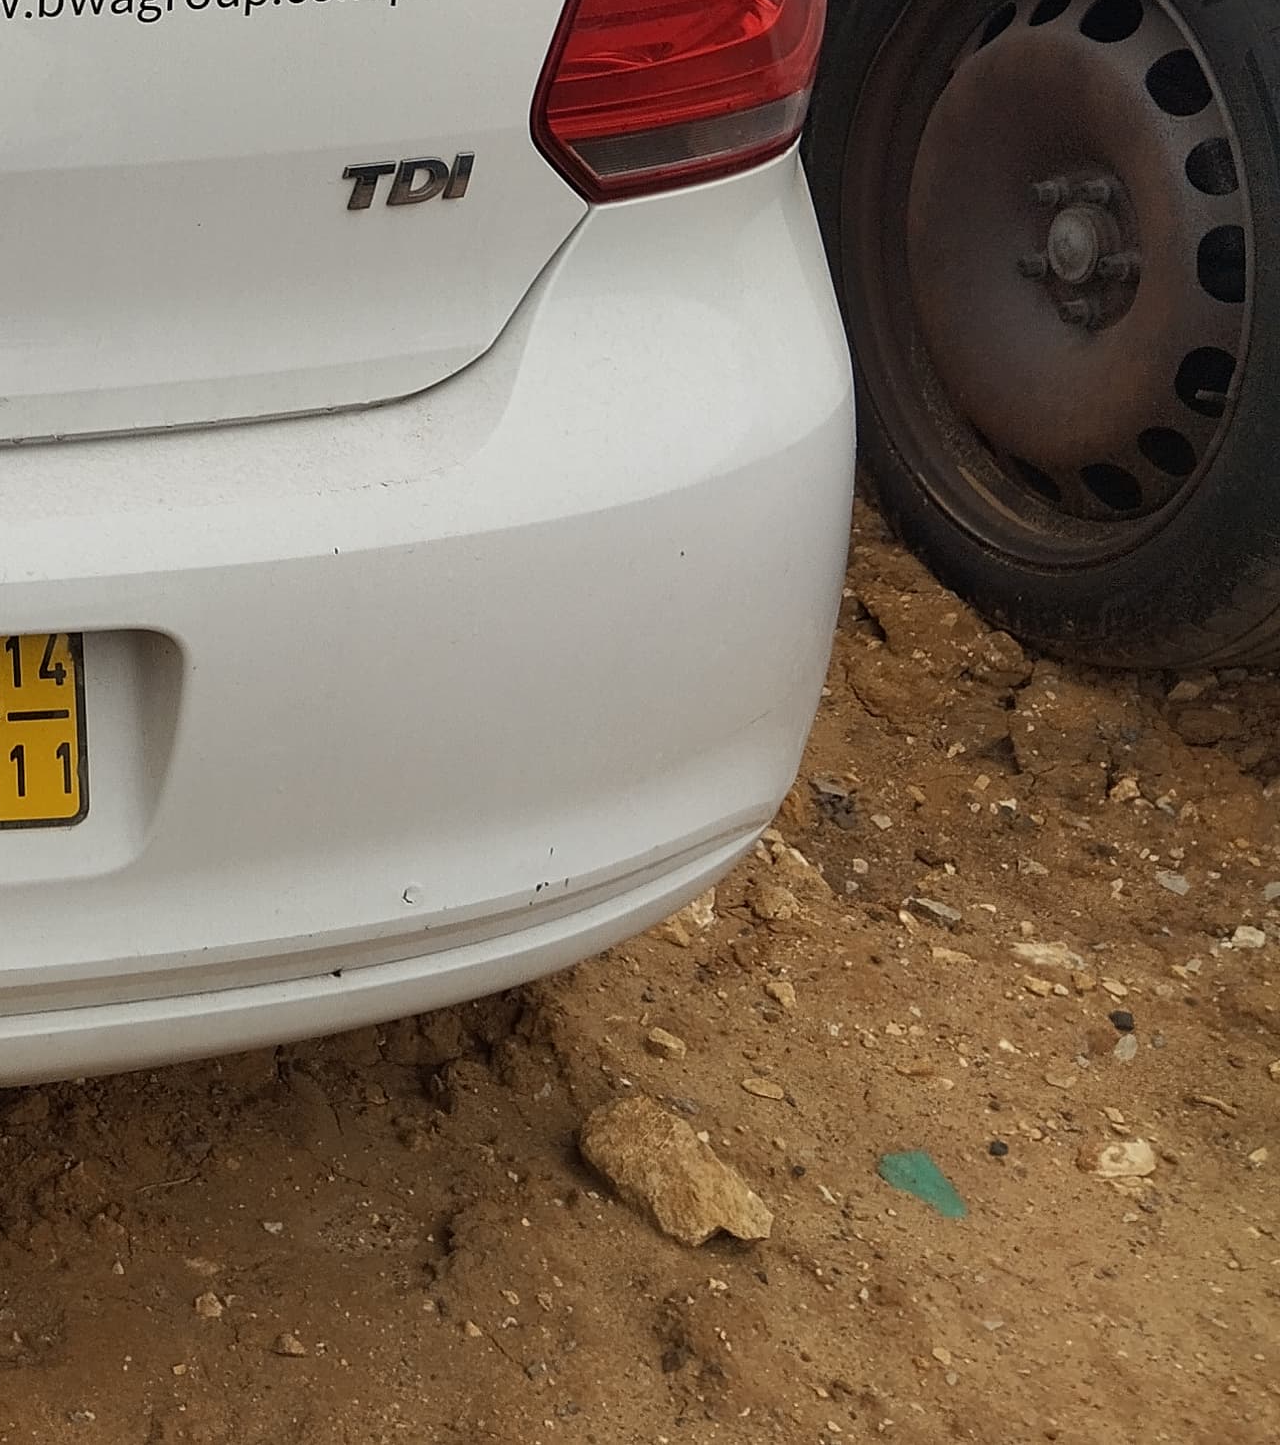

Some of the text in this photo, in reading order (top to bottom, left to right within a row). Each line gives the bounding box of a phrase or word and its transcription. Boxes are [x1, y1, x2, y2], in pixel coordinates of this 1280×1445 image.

[343, 152, 474, 211] TDI
[5, 634, 67, 688] 14
[10, 742, 72, 797] 11
